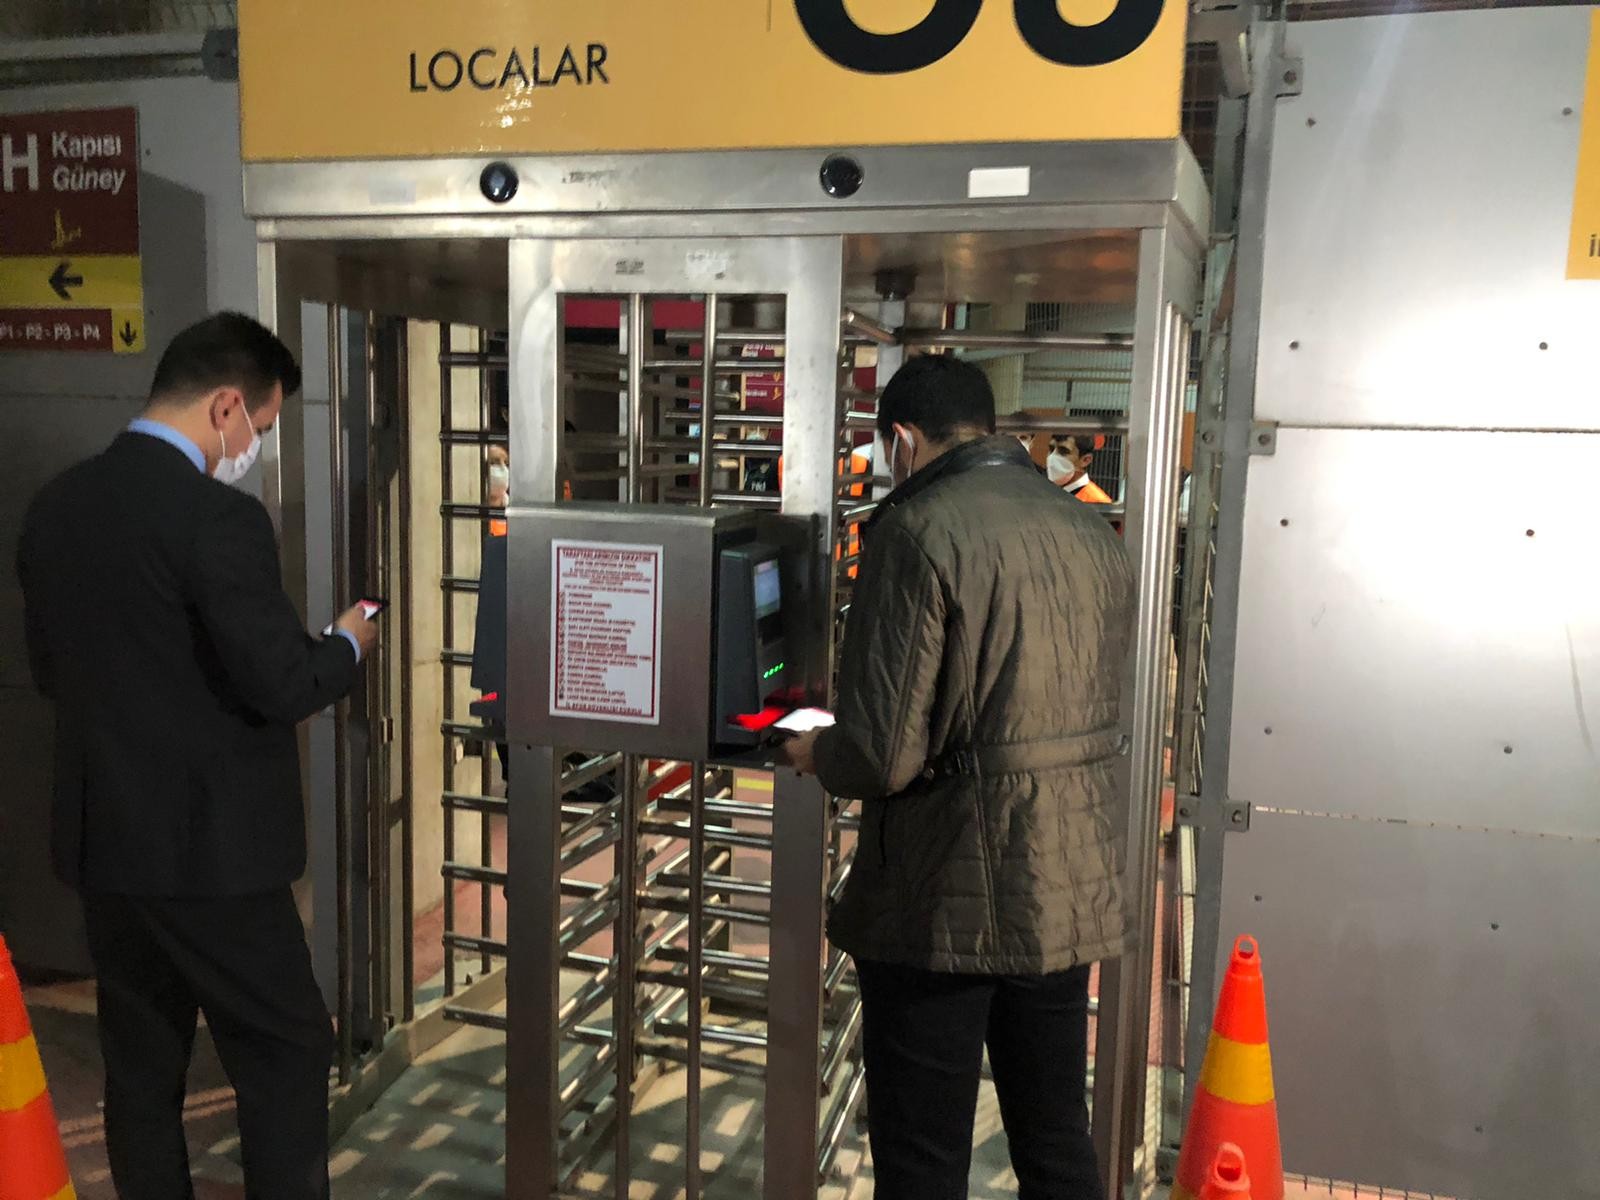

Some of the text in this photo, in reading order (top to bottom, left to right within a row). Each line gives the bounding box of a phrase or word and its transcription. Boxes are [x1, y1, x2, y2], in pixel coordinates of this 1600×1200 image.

[410, 43, 609, 92] LOCALAR
[2, 133, 39, 192] H
[52, 163, 126, 195] Güney
